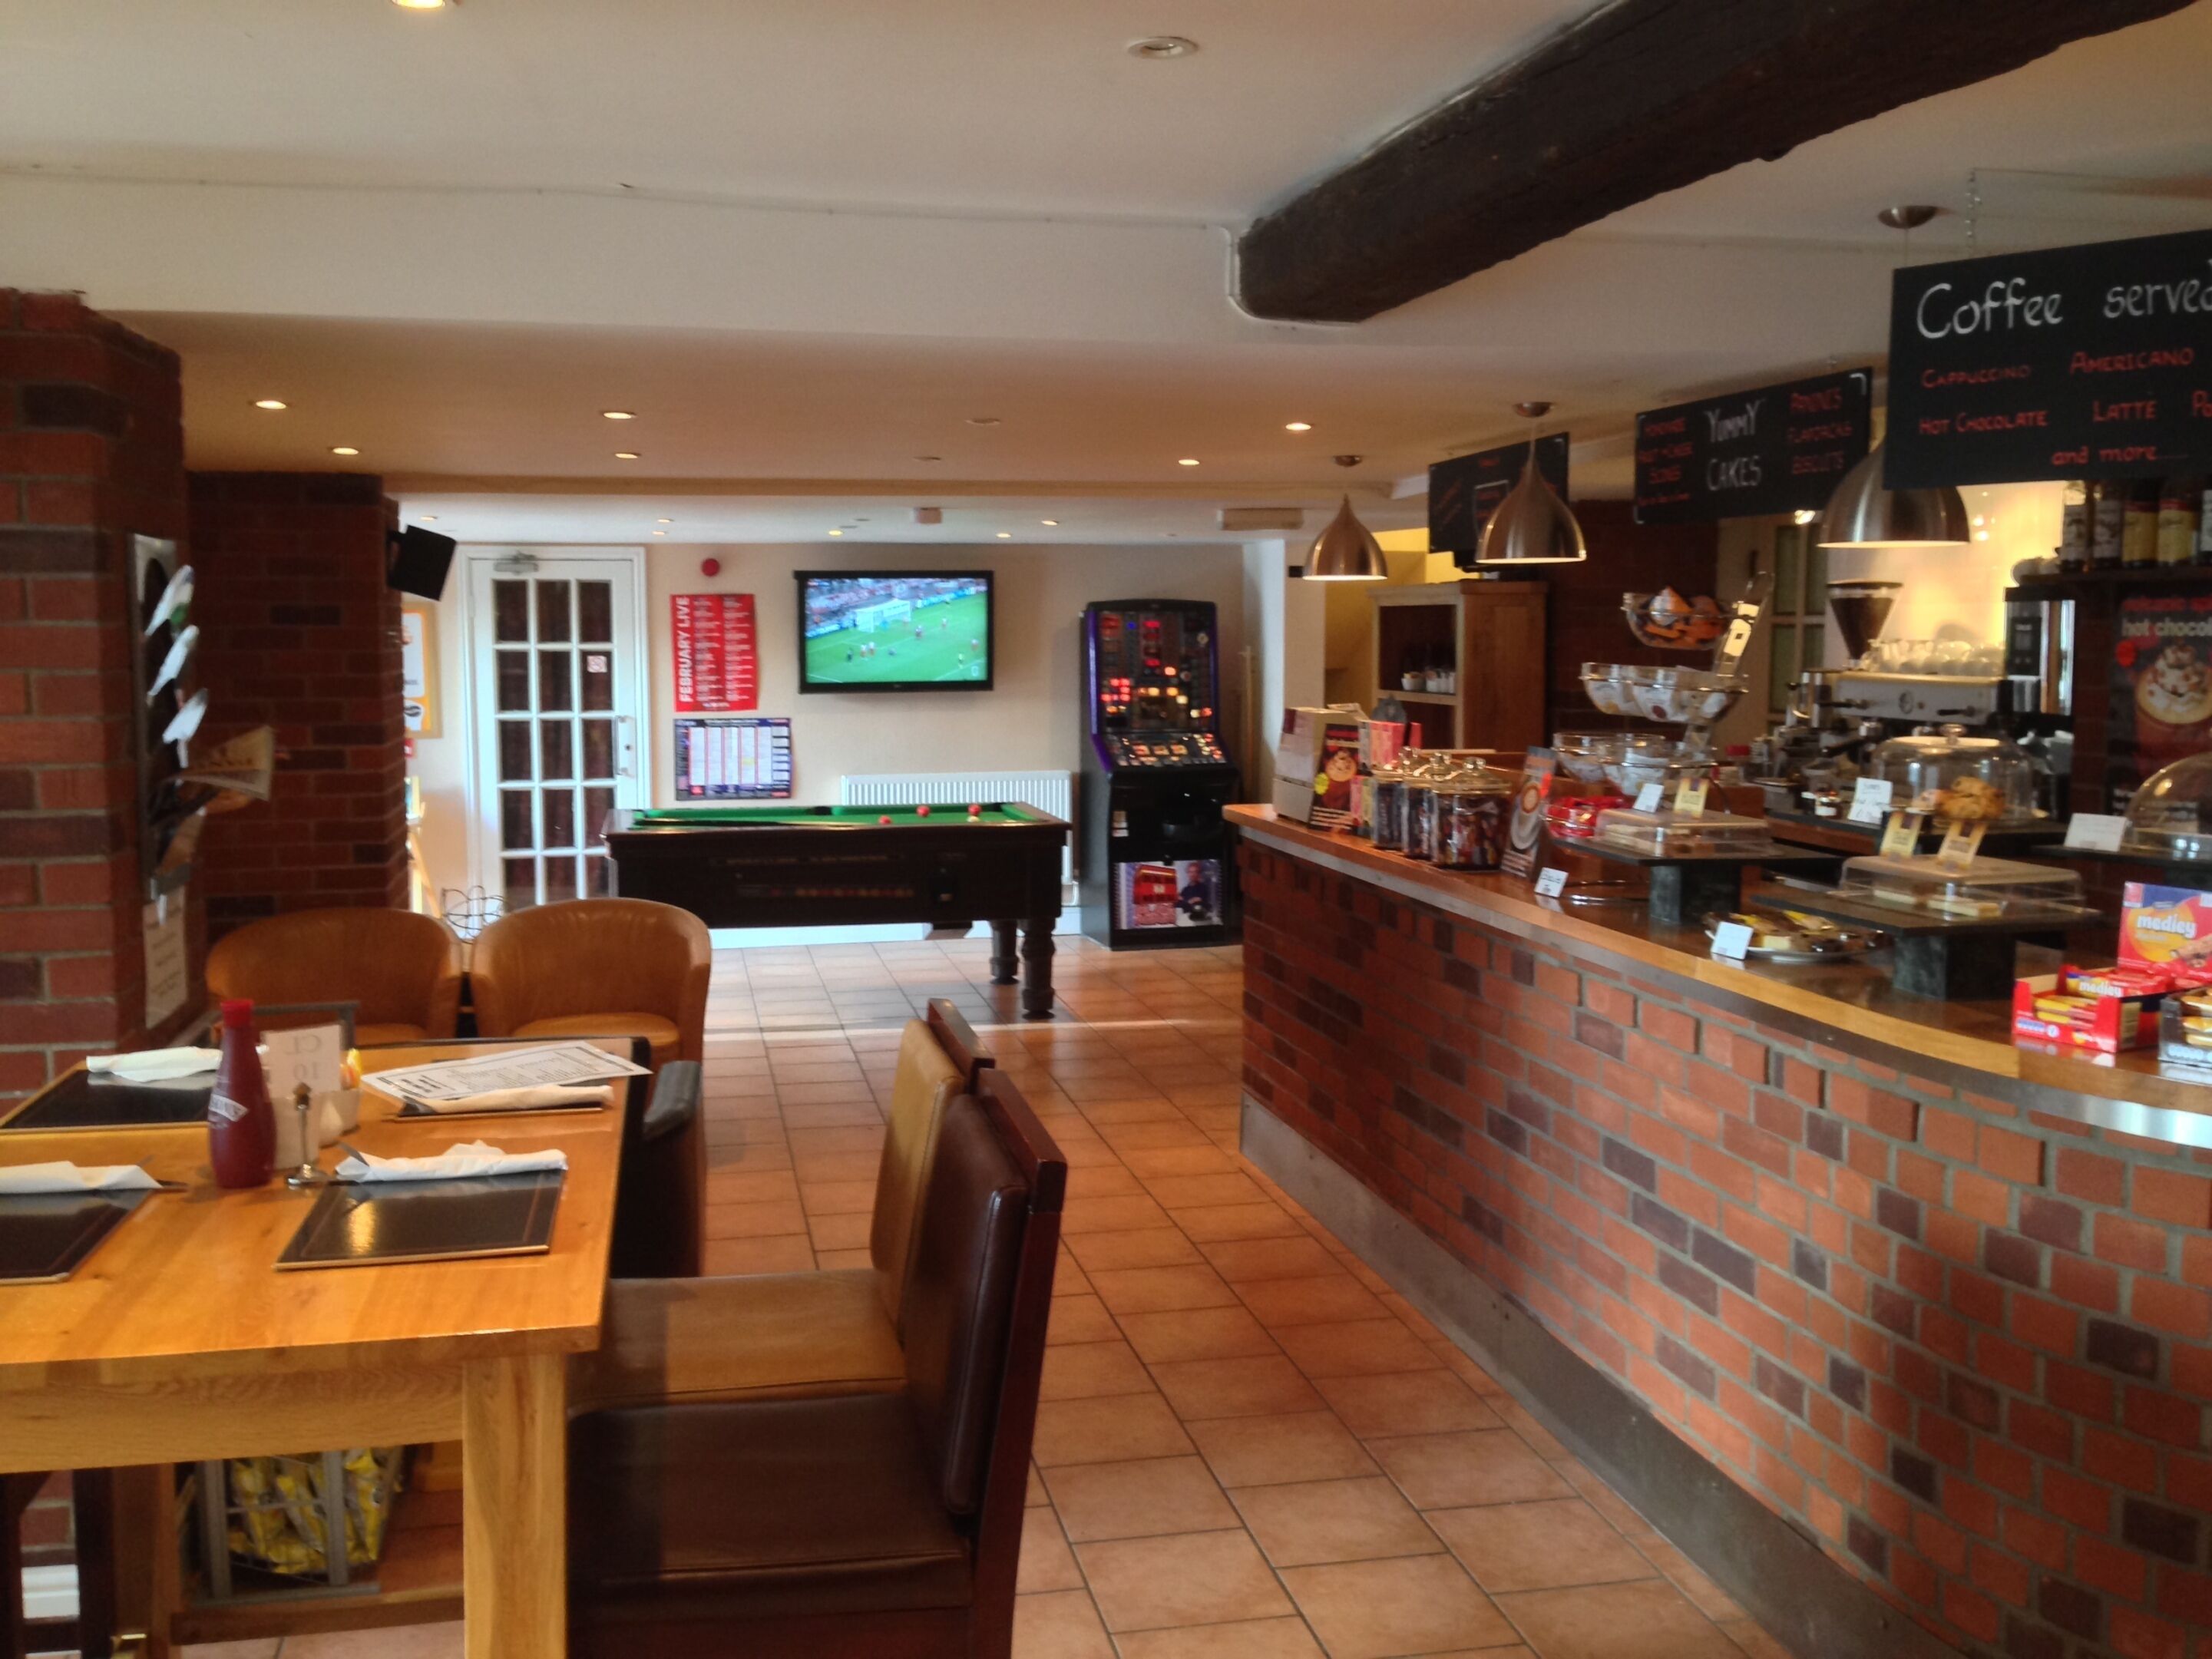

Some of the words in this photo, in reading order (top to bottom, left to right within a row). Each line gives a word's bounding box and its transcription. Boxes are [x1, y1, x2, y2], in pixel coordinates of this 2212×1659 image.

[1916, 277, 2064, 339] Coffee
[1919, 417, 1951, 435] HOT
[1955, 410, 2049, 433] CHOCOLATE
[2093, 399, 2157, 423] LATTE
[2051, 445, 2089, 466] and
[1707, 455, 1762, 492] CAKES
[676, 597, 691, 628] LIVE
[676, 630, 694, 702] FEBRUARY
[2137, 913, 2197, 940] medley
[2078, 979, 2122, 998] medley
